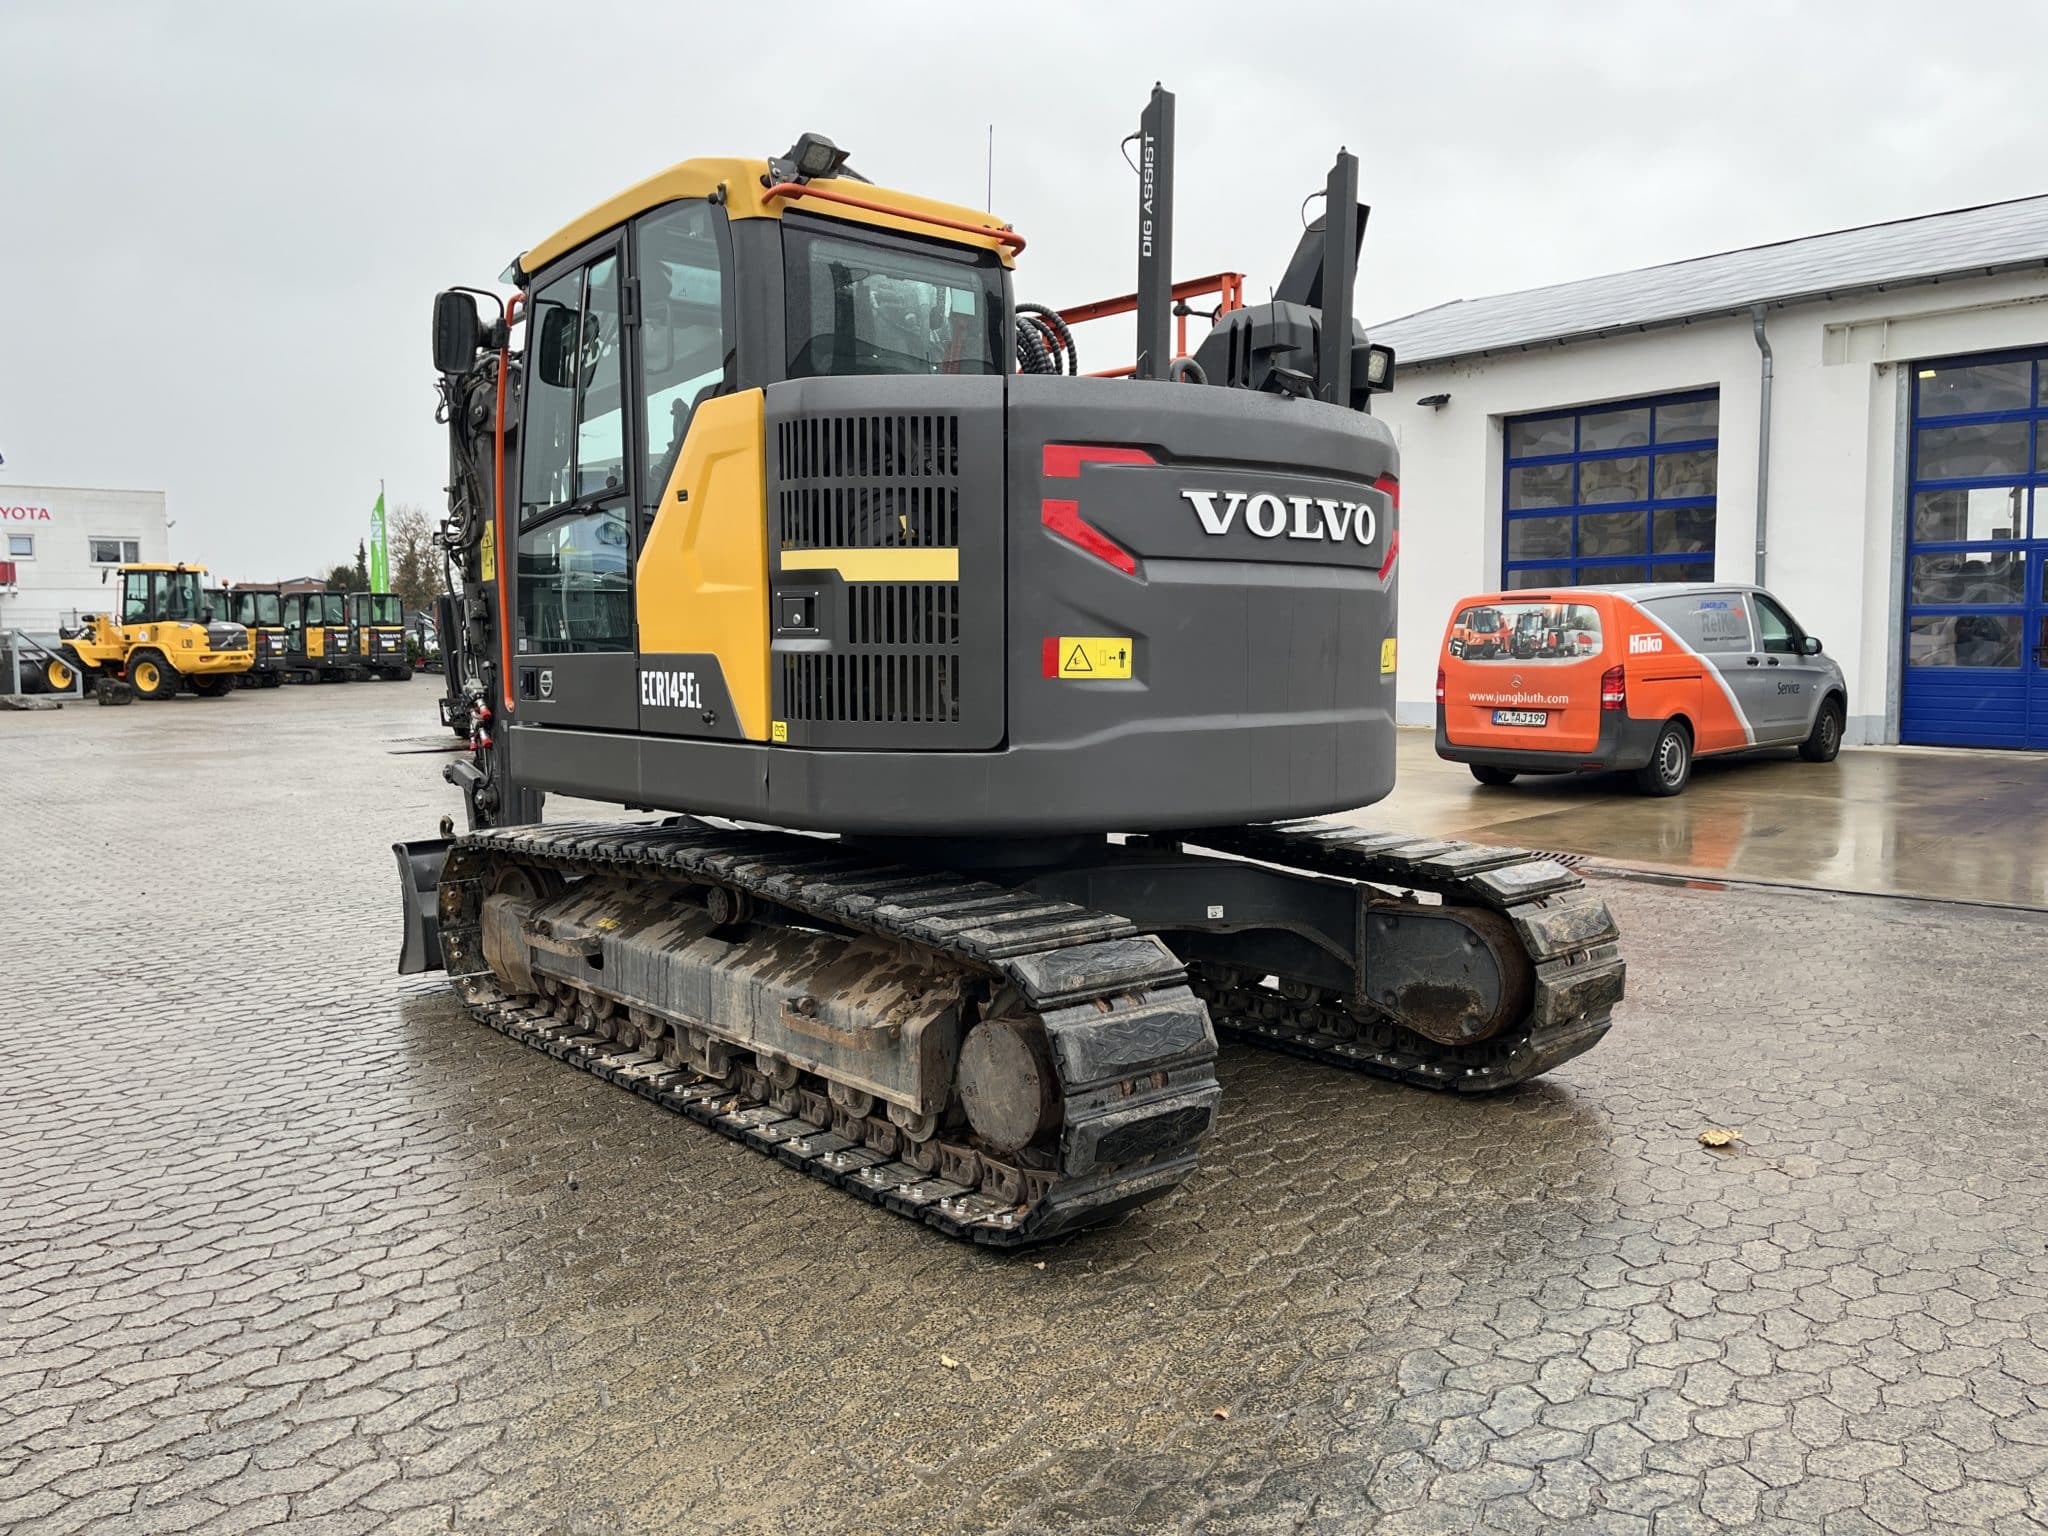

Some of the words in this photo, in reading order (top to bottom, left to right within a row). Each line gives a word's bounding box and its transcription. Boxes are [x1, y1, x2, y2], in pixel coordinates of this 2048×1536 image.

[1144, 131, 1154, 215] ASSIST
[1143, 220, 1152, 257] DIG
[1181, 490, 1376, 546] VOLVO
[1469, 692, 1569, 705] www.jungbluth.com
[1777, 681, 1800, 695] Service
[1498, 713, 1509, 721] KL
